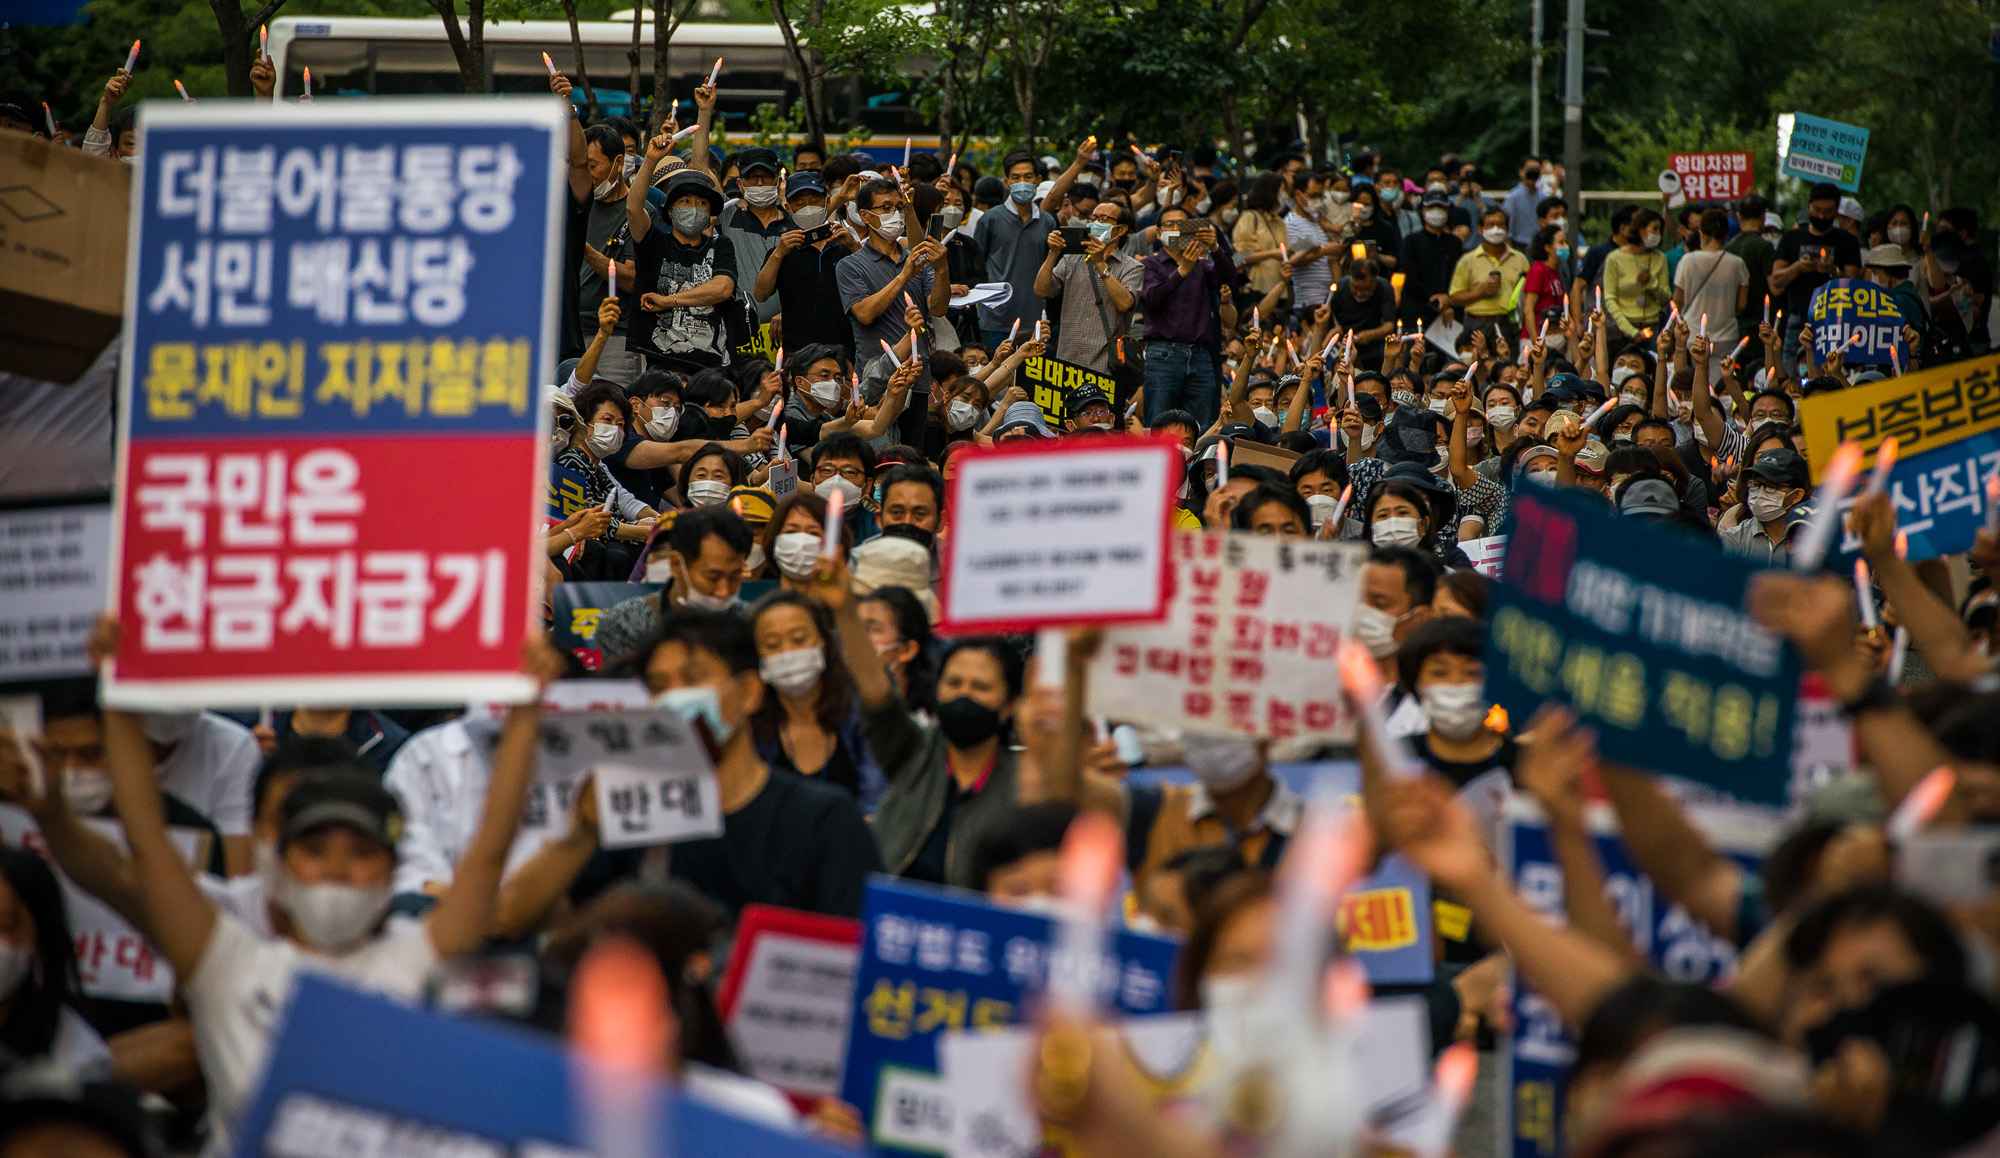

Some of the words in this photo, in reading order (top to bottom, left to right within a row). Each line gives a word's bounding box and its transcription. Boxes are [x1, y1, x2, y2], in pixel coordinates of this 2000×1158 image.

[157, 144, 523, 234] 더불어불통당
[1675, 153, 1746, 174] 임대차3법
[1684, 174, 1740, 199] 위헌!
[148, 237, 275, 329] 서민
[288, 235, 475, 327] 배신당
[1813, 287, 1902, 321] 집주인도
[1815, 322, 1904, 356] 국민이다
[143, 339, 306, 421] 문재인
[1025, 356, 1116, 405] 임대차3법
[1034, 383, 1068, 425] 반
[135, 448, 366, 550] 국민은
[133, 550, 507, 654] 현금지급기
[611, 777, 703, 832] 반대
[75, 932, 156, 983] 반대
